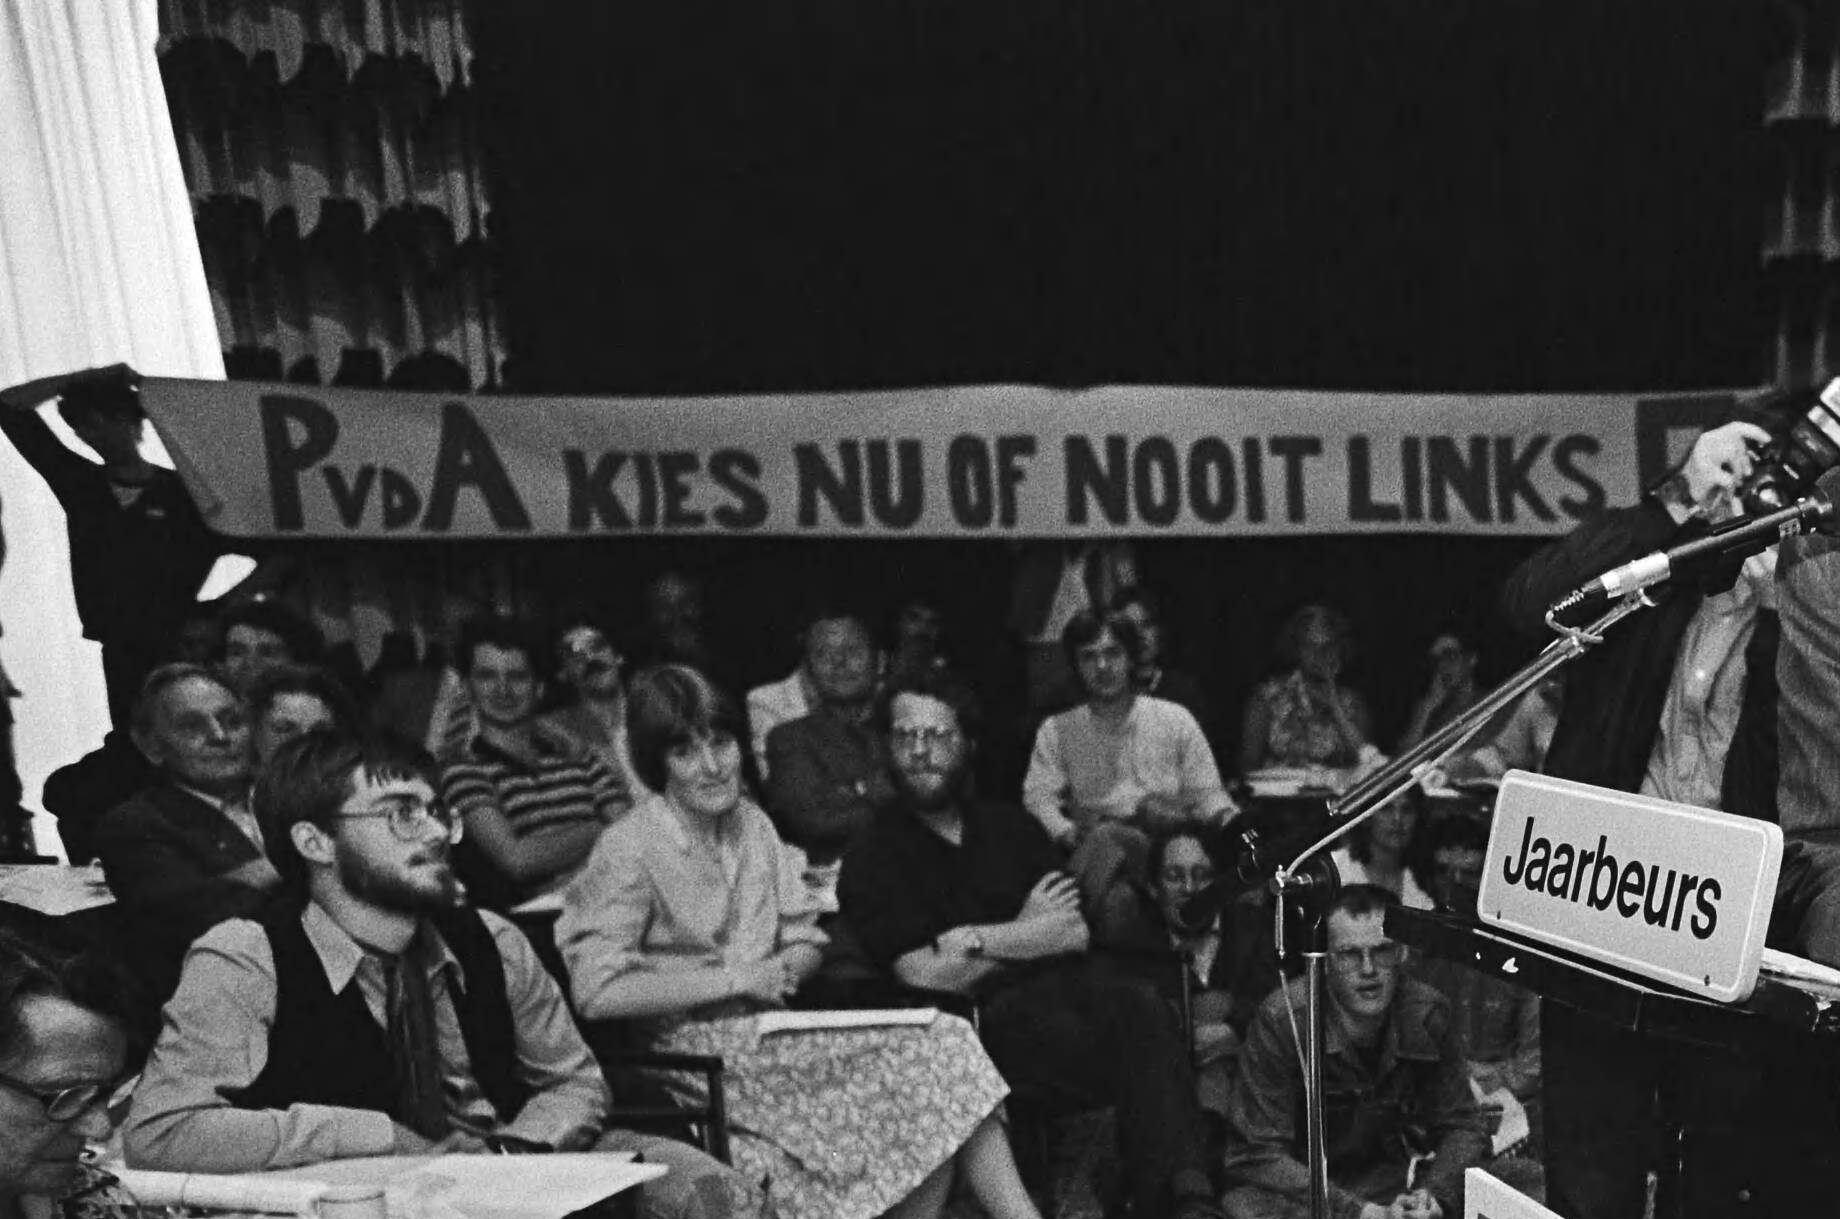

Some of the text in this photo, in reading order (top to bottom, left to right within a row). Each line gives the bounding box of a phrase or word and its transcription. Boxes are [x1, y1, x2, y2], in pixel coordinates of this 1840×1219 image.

[562, 447, 769, 533] KIES
[795, 438, 926, 530] NU
[947, 433, 1036, 529] OF
[1064, 433, 1323, 529] NOOIT
[1347, 433, 1606, 524] LINKS
[1503, 816, 1722, 939] Jaarbeurs
